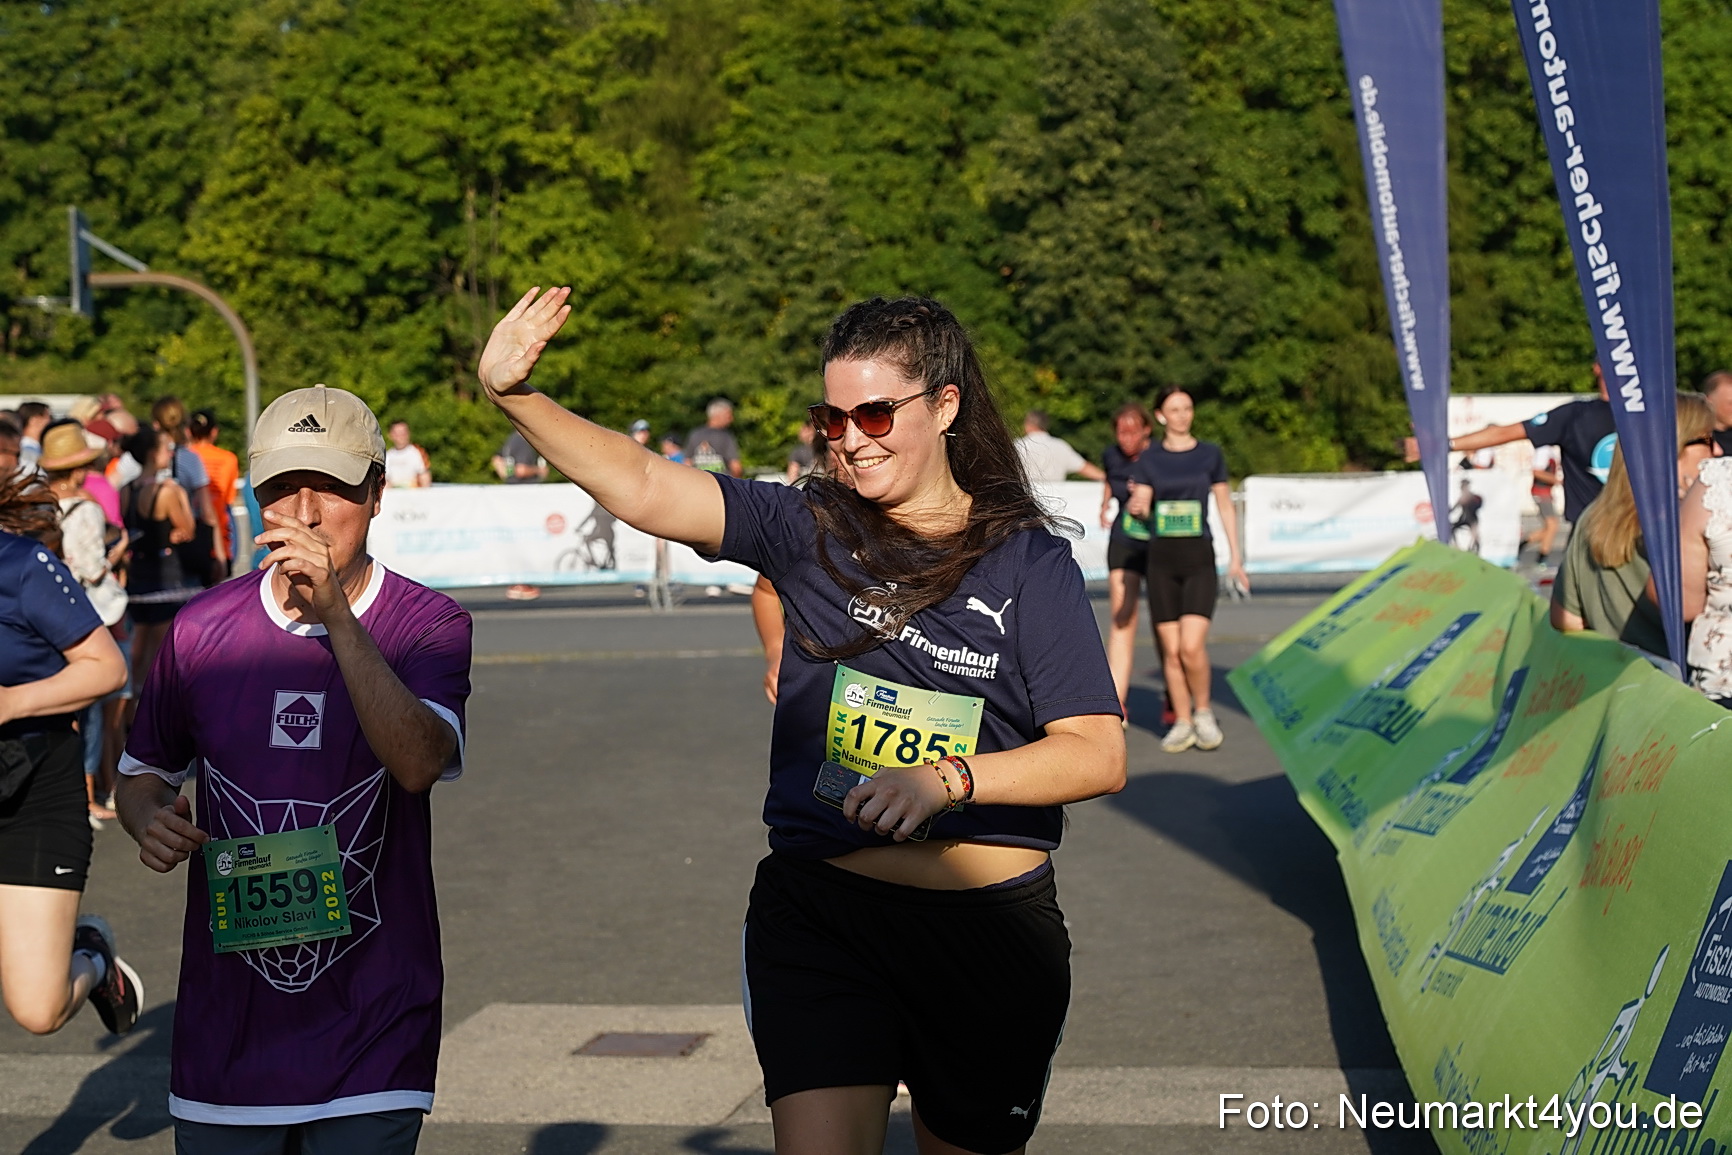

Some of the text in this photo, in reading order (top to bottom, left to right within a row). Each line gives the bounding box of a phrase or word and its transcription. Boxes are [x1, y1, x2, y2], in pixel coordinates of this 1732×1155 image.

[899, 624, 1000, 669] Firmenlauf
[933, 660, 997, 680] neumarkt
[866, 699, 913, 715] Firmenlauf
[882, 710, 911, 720] neumarkt
[275, 713, 320, 726] FUCHS
[832, 710, 848, 764] WALK
[851, 714, 950, 764] 1785
[234, 854, 272, 869] Firmenlauf
[248, 861, 272, 871] neumarkt
[228, 868, 318, 913] 1559
[321, 870, 341, 921] 2022
[216, 892, 228, 930] RUN
[234, 907, 317, 929] Nikolov Slavi
